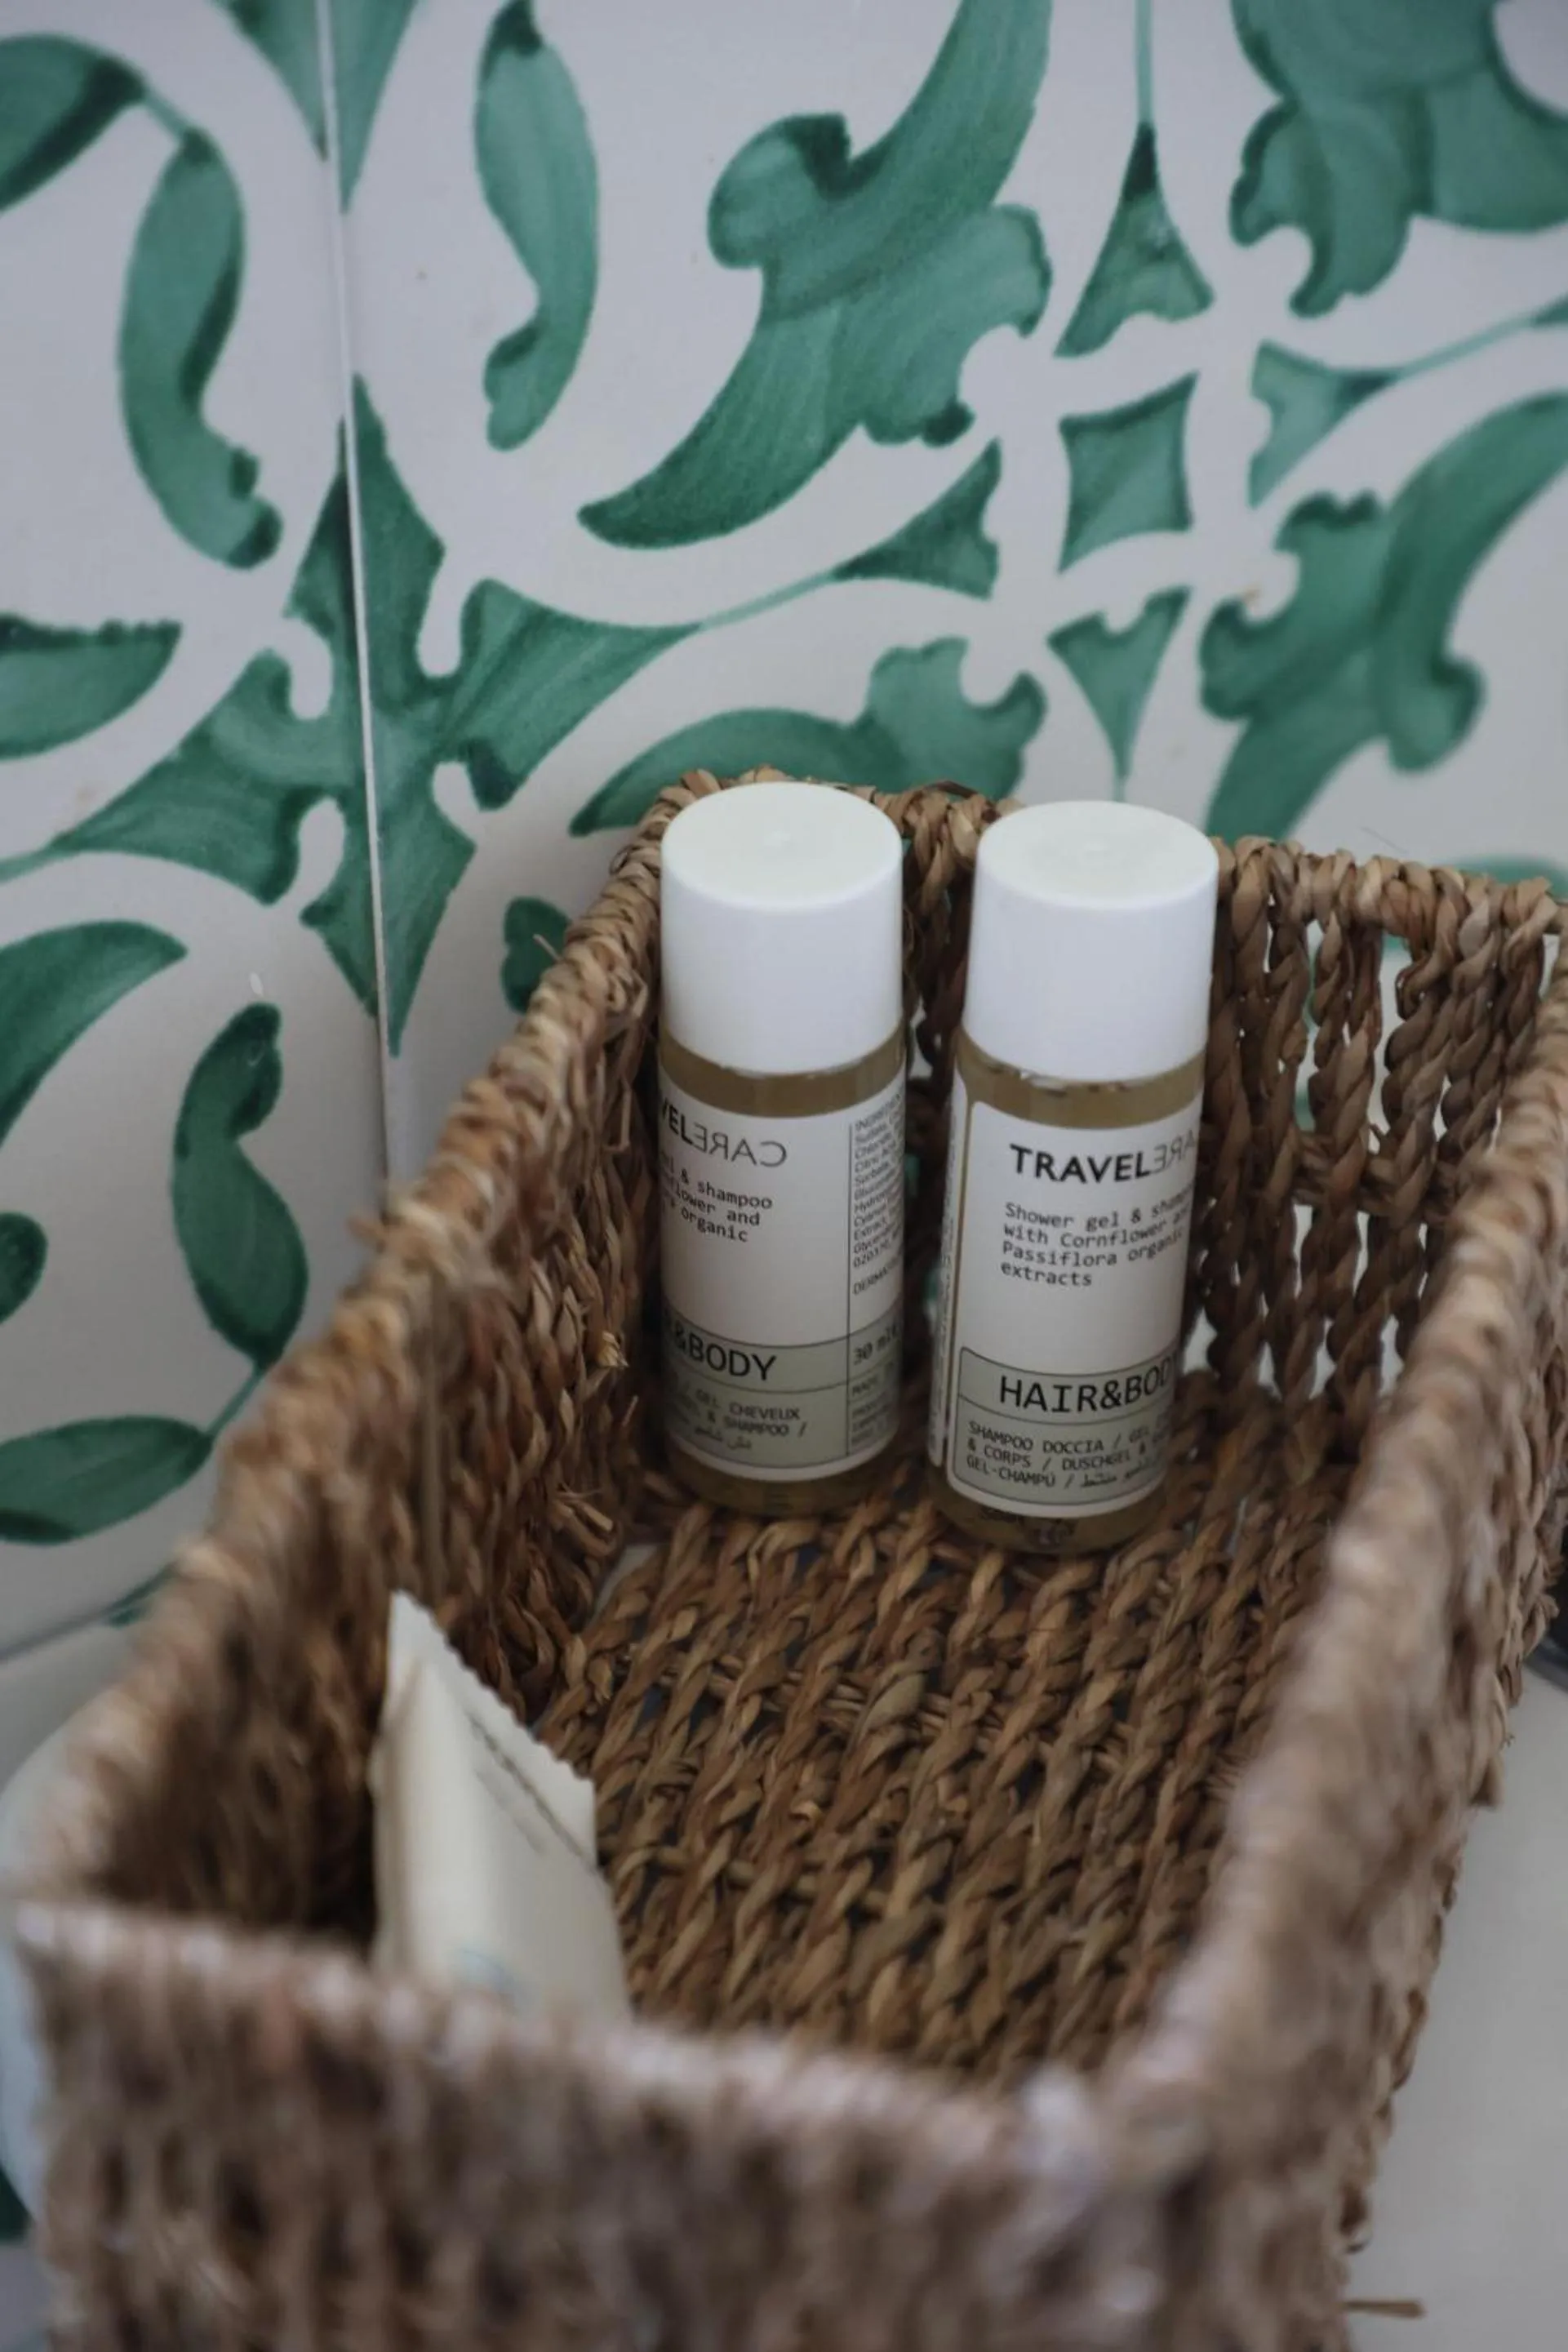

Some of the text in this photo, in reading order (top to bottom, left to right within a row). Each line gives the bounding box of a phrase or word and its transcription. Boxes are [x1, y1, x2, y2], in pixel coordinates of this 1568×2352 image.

[1009, 1143, 1151, 1185] TRAVEL
[697, 1181, 773, 1210] shampoo
[681, 1206, 749, 1243] organic
[726, 1209, 761, 1226] and
[1005, 1202, 1074, 1228] Shower
[1086, 1211, 1119, 1233] gel
[1003, 1223, 1048, 1245] with
[1060, 1218, 1167, 1248] Cornflower
[1002, 1240, 1117, 1267] Passiflora
[1001, 1262, 1092, 1287] extracts
[674, 1319, 777, 1381] &BODY
[1000, 1355, 1172, 1413] HAIR&BOD
[729, 1402, 802, 1421] CHEVEUX
[969, 1421, 1033, 1451] SHAMPOO
[1042, 1439, 1104, 1454] DOCCIA
[984, 1444, 1032, 1469] CORPS
